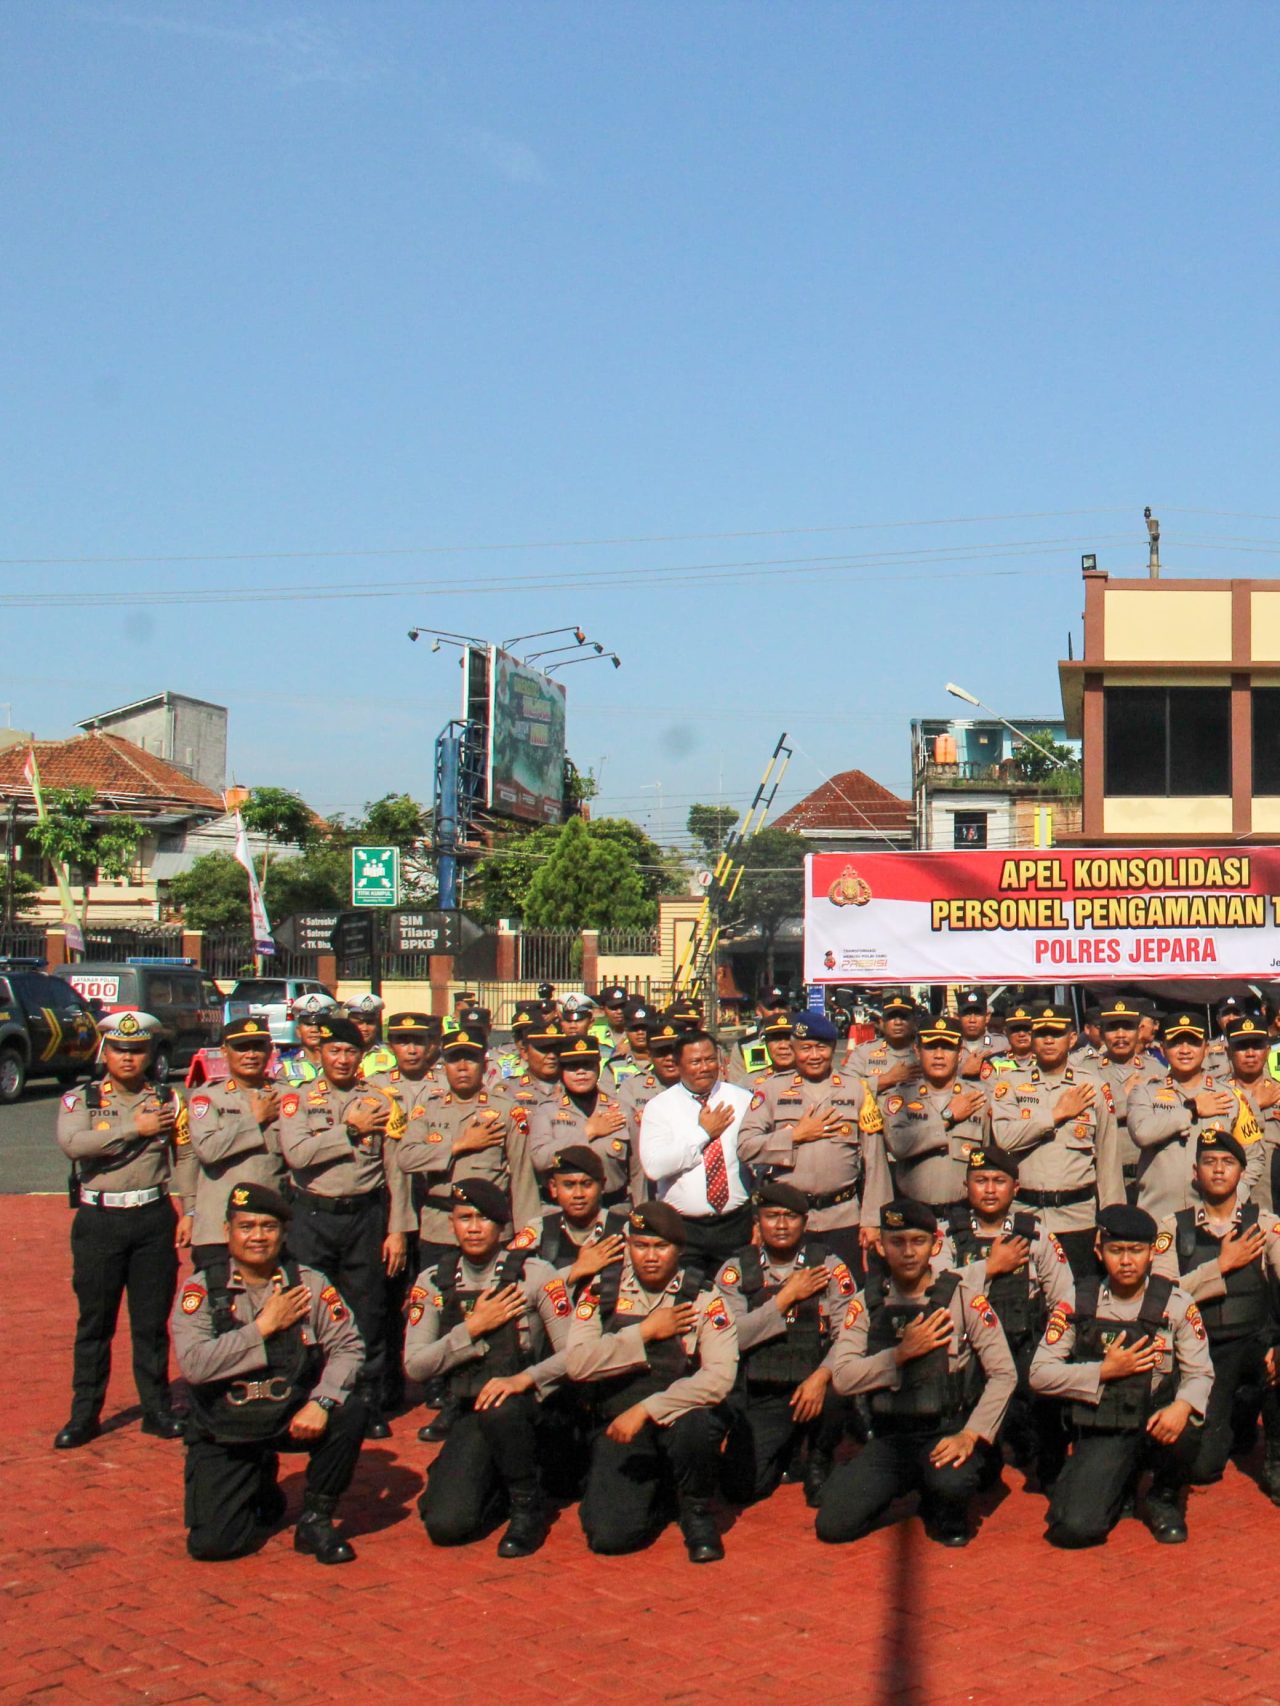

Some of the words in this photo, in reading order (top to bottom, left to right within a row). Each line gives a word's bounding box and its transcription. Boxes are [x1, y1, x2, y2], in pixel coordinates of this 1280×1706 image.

[999, 858, 1067, 890] APEL
[1073, 856, 1250, 889] KONSOLIDASI
[932, 898, 1069, 930] PERSONEL
[1074, 895, 1265, 929] PENGAMANAN
[400, 916, 423, 926] SIM
[400, 928, 439, 939] Tilang
[401, 940, 435, 949] BPKB
[1035, 938, 1121, 964] POLRES
[1128, 937, 1217, 963] JEPARA
[75, 983, 116, 997] 110
